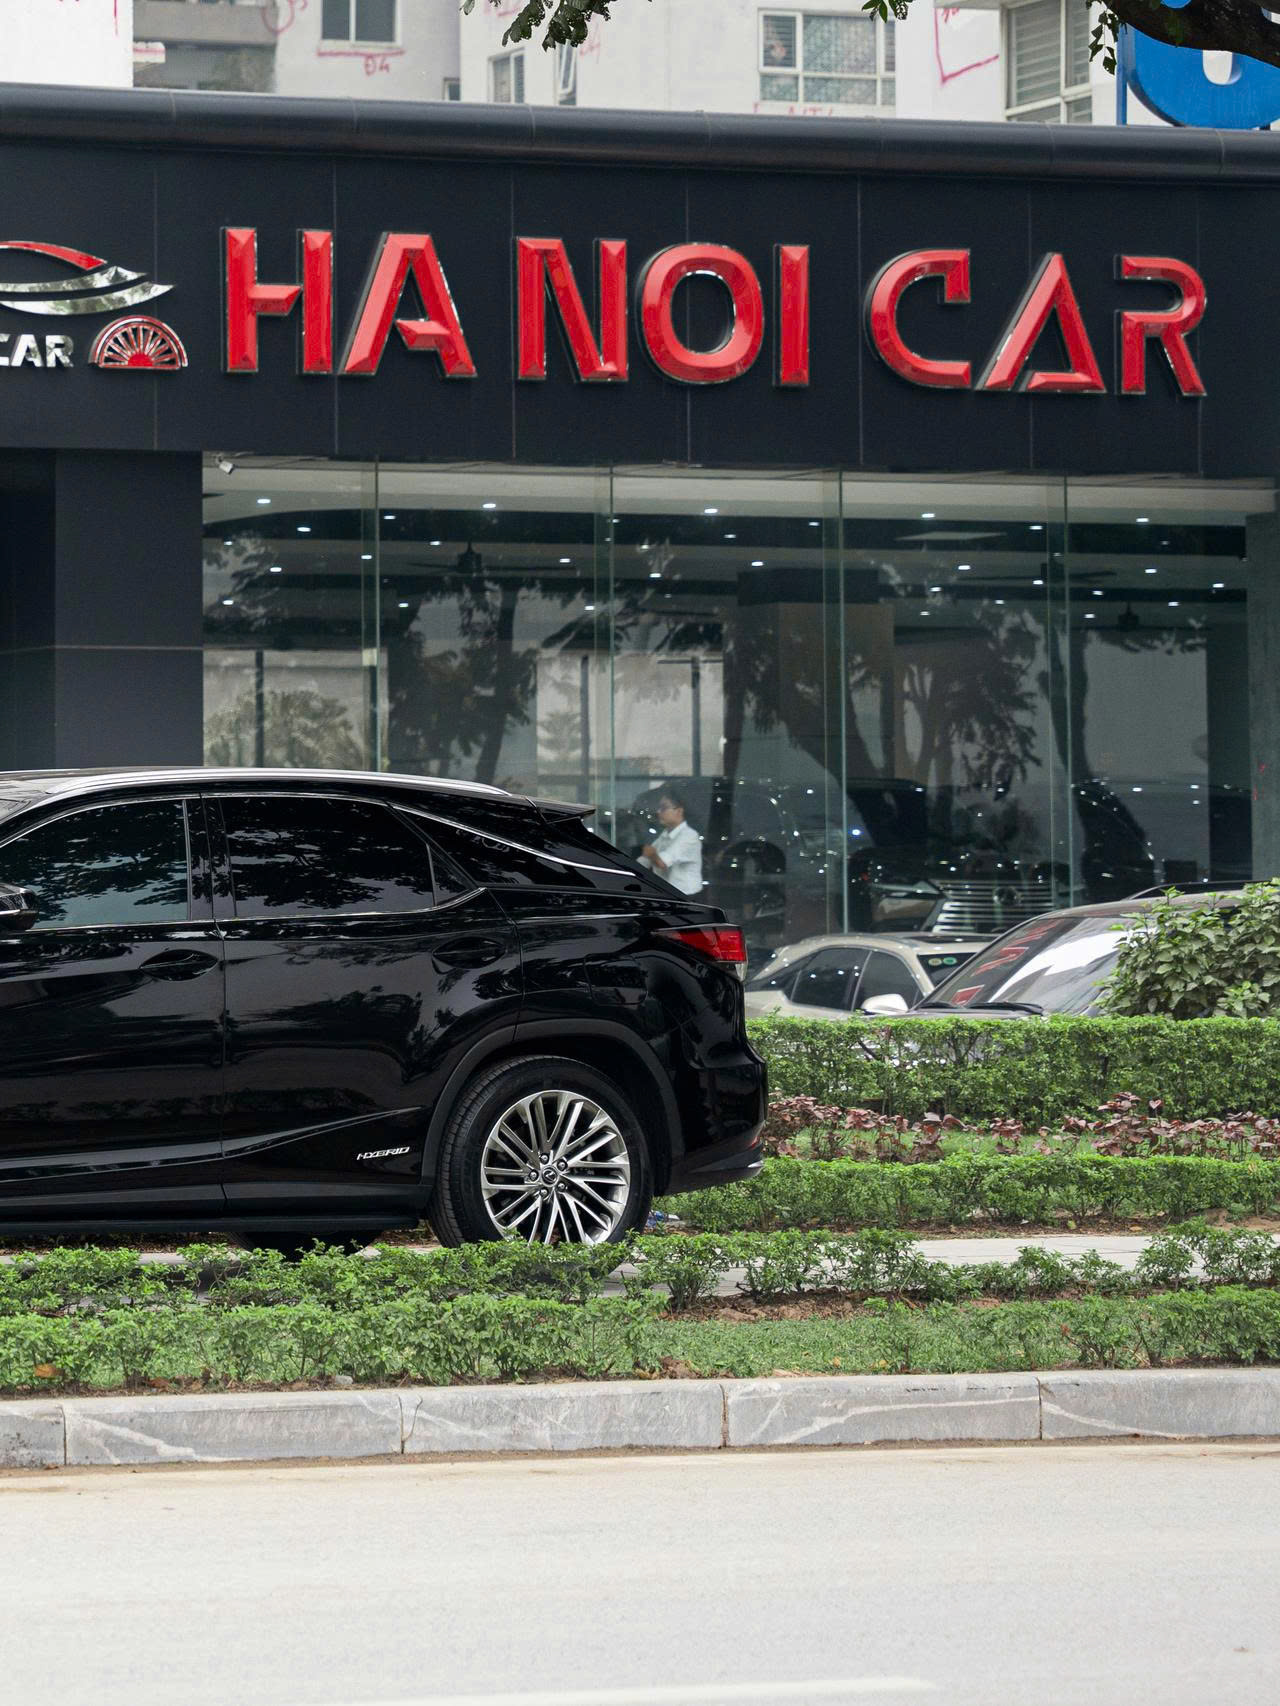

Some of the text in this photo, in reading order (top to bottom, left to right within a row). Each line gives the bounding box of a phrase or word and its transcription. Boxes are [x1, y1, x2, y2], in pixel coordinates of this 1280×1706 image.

[222, 227, 1208, 397] HA NOI CAR
[356, 1146, 410, 1161] HYBRID
